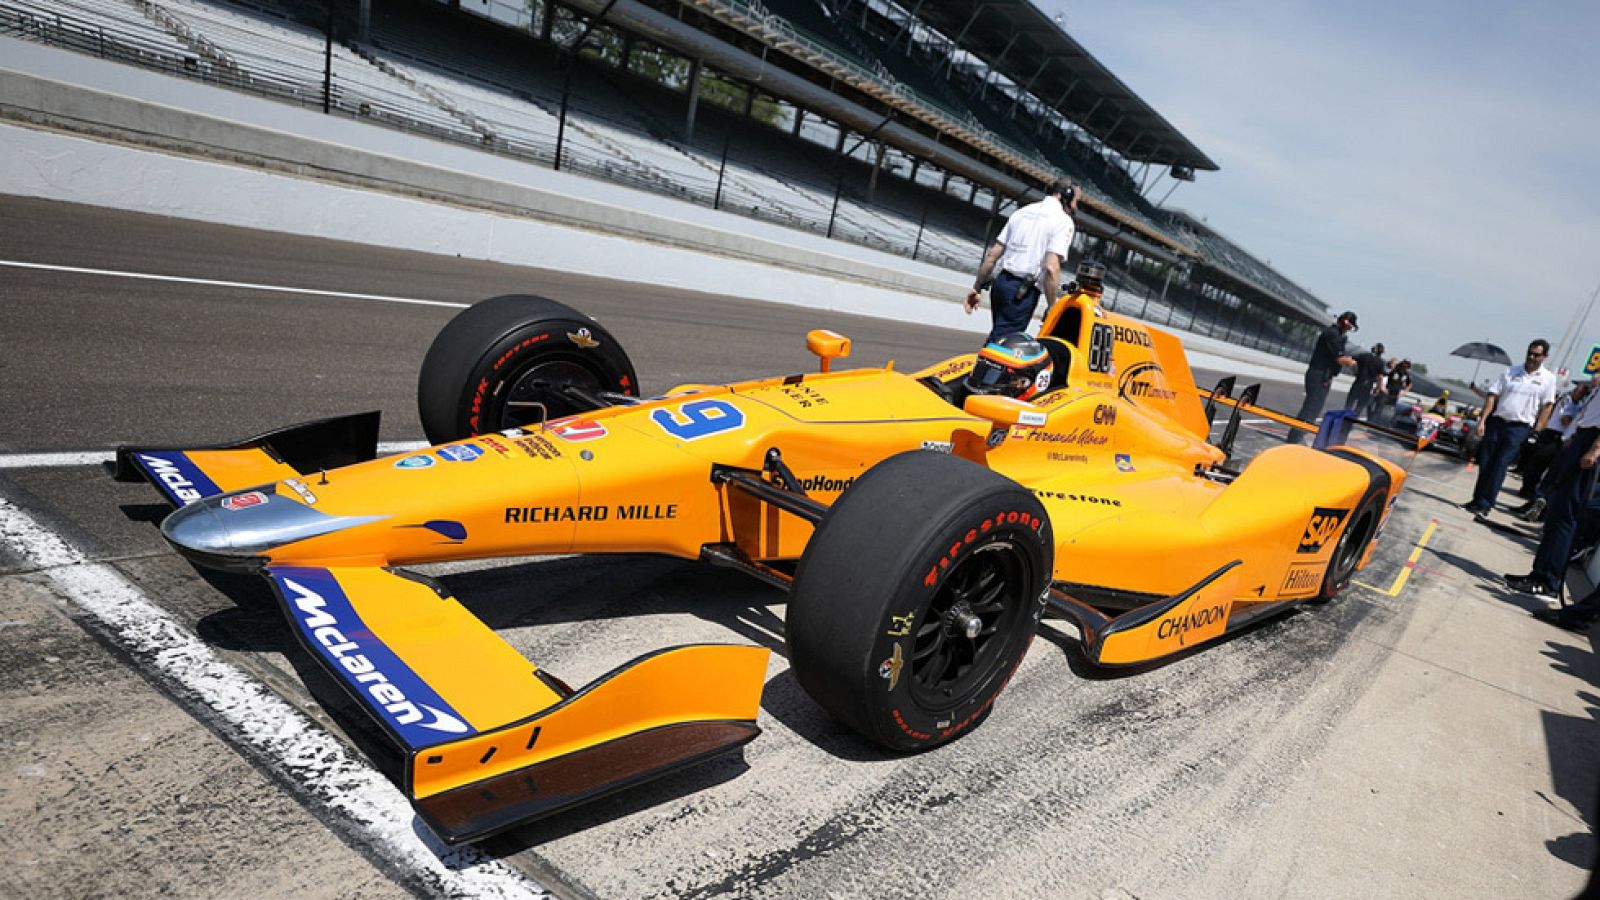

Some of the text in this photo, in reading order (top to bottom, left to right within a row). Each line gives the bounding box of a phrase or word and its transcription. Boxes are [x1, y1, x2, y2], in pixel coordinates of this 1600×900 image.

[1113, 325, 1153, 348] HOND
[1032, 488, 1122, 507] irestone
[504, 504, 678, 523] RICHARD MILLE
[1300, 515, 1339, 546] SAP
[923, 511, 1041, 587] Firestone
[1284, 568, 1319, 589] Hilton
[1157, 601, 1229, 646] CHANDON
[283, 577, 425, 726] McLaren
